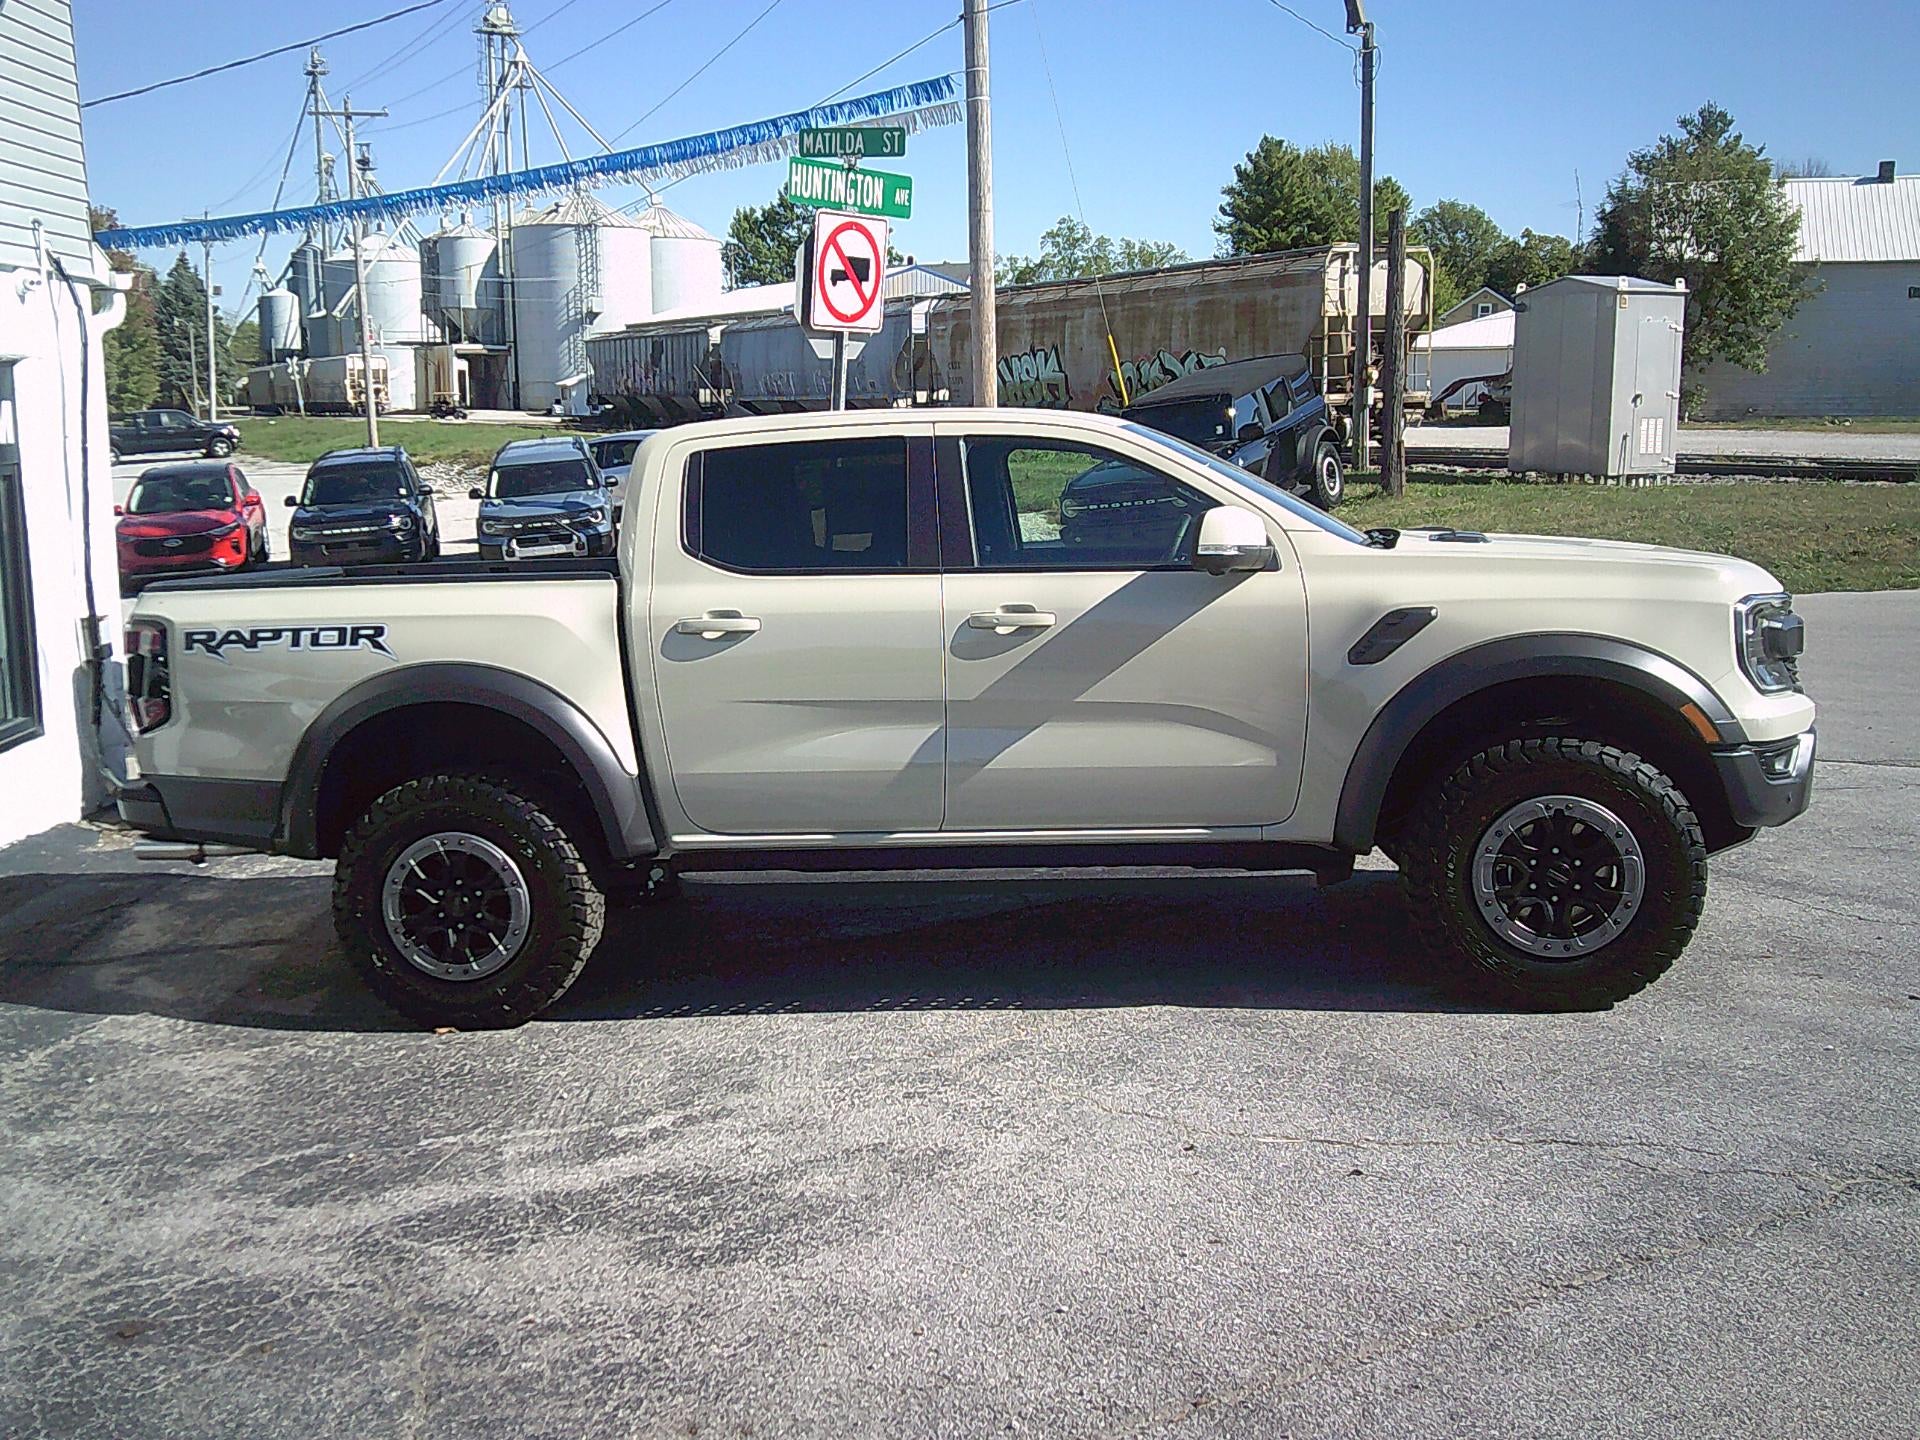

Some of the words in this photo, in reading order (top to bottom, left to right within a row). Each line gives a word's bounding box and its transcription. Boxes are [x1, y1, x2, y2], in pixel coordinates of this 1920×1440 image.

[803, 132, 865, 154] MATILDA
[882, 131, 901, 153] ST
[791, 162, 884, 208] HUNTINGTON
[894, 188, 910, 206] AVE
[1088, 499, 1156, 510] BRONCO
[184, 624, 397, 662] RAPTOR
